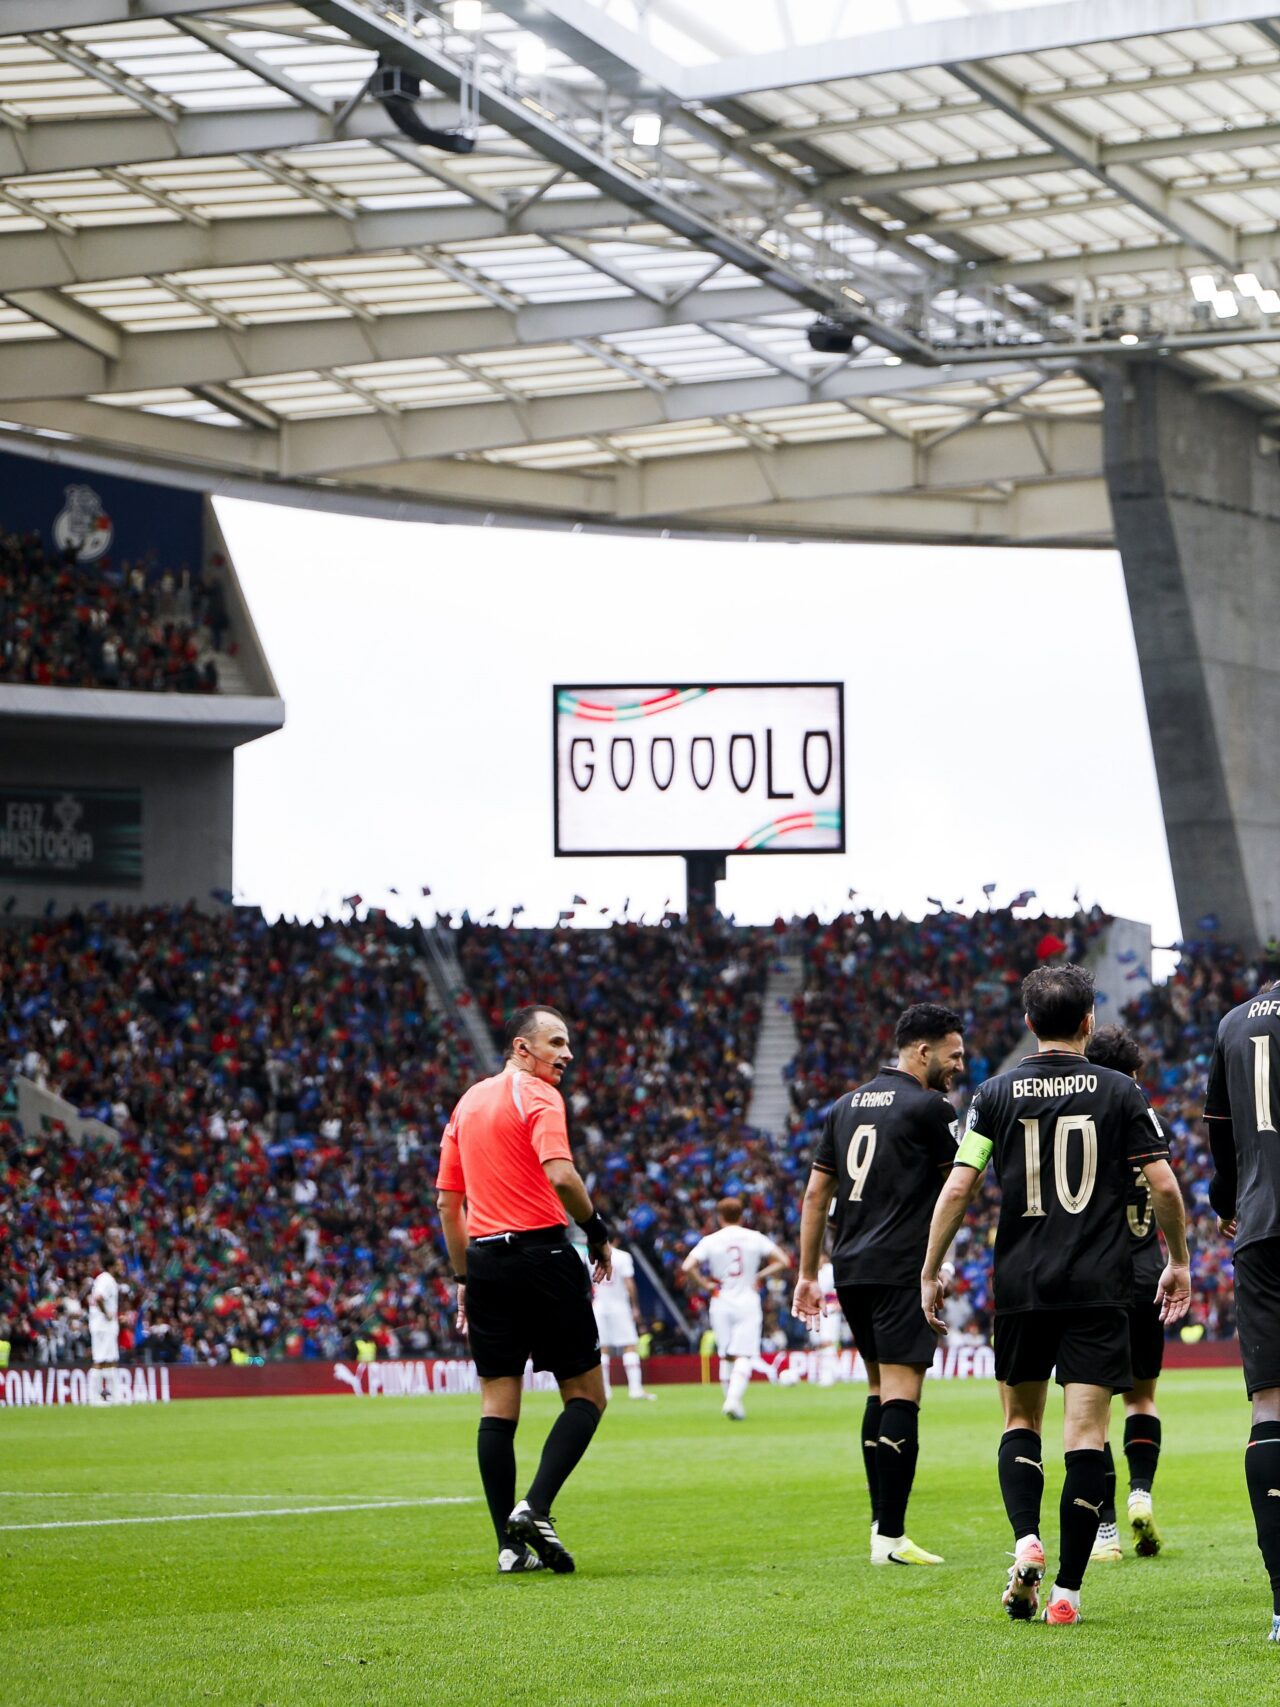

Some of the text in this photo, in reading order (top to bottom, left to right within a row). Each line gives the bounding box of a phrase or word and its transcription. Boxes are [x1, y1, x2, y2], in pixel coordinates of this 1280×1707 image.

[570, 728, 833, 799] GOOOOLO
[6, 802, 45, 830] FAZ
[1012, 1074, 1098, 1098] BERNARDO
[846, 1124, 877, 1201] 9
[1018, 1114, 1098, 1217] 10
[726, 1245, 745, 1277] 3
